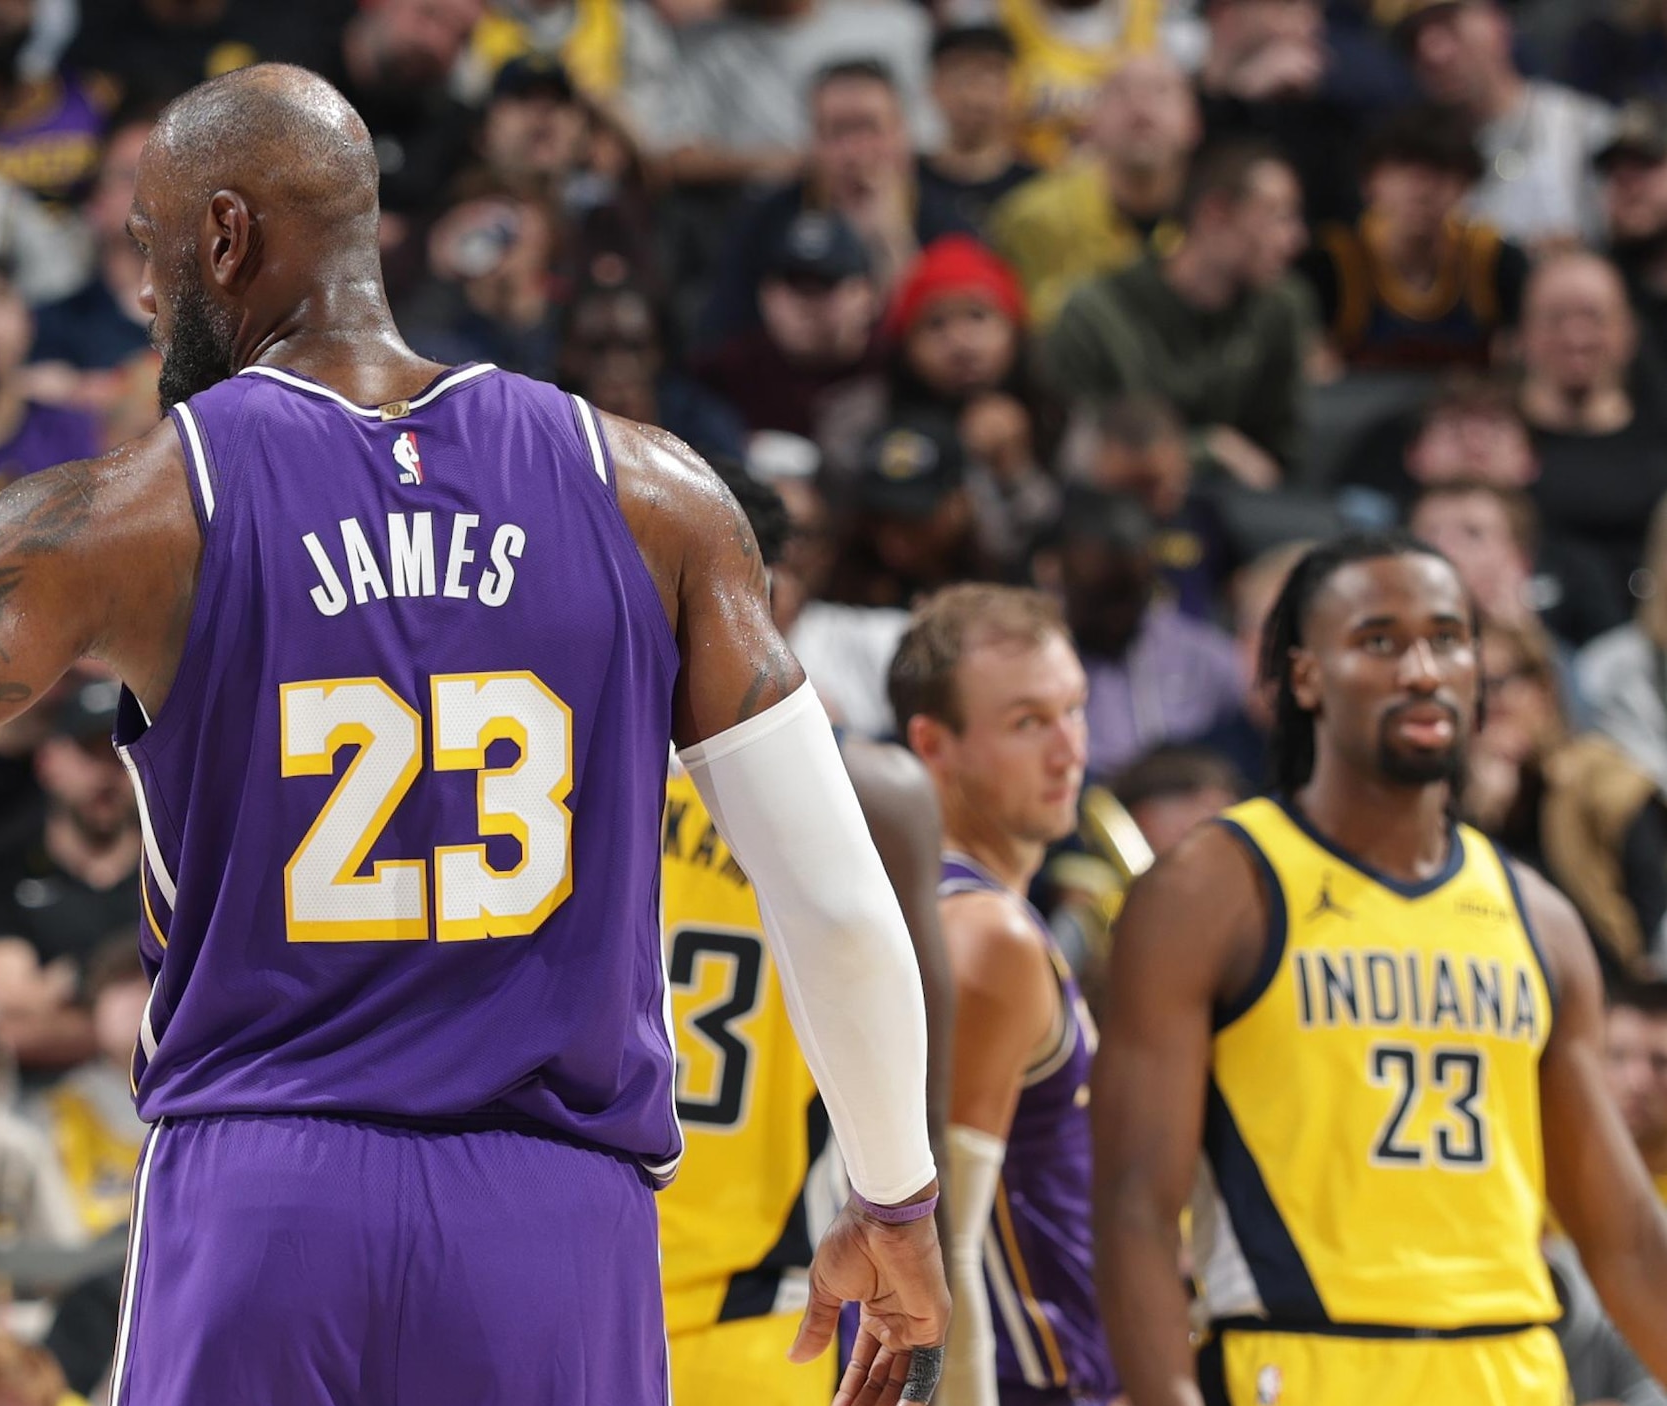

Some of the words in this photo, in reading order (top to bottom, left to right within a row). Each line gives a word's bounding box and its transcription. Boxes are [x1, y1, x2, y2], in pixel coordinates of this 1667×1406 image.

[302, 511, 525, 617] JAMES
[279, 670, 573, 943] 23
[1292, 949, 1540, 1044] INDIANA
[1370, 1044, 1489, 1168] 23
